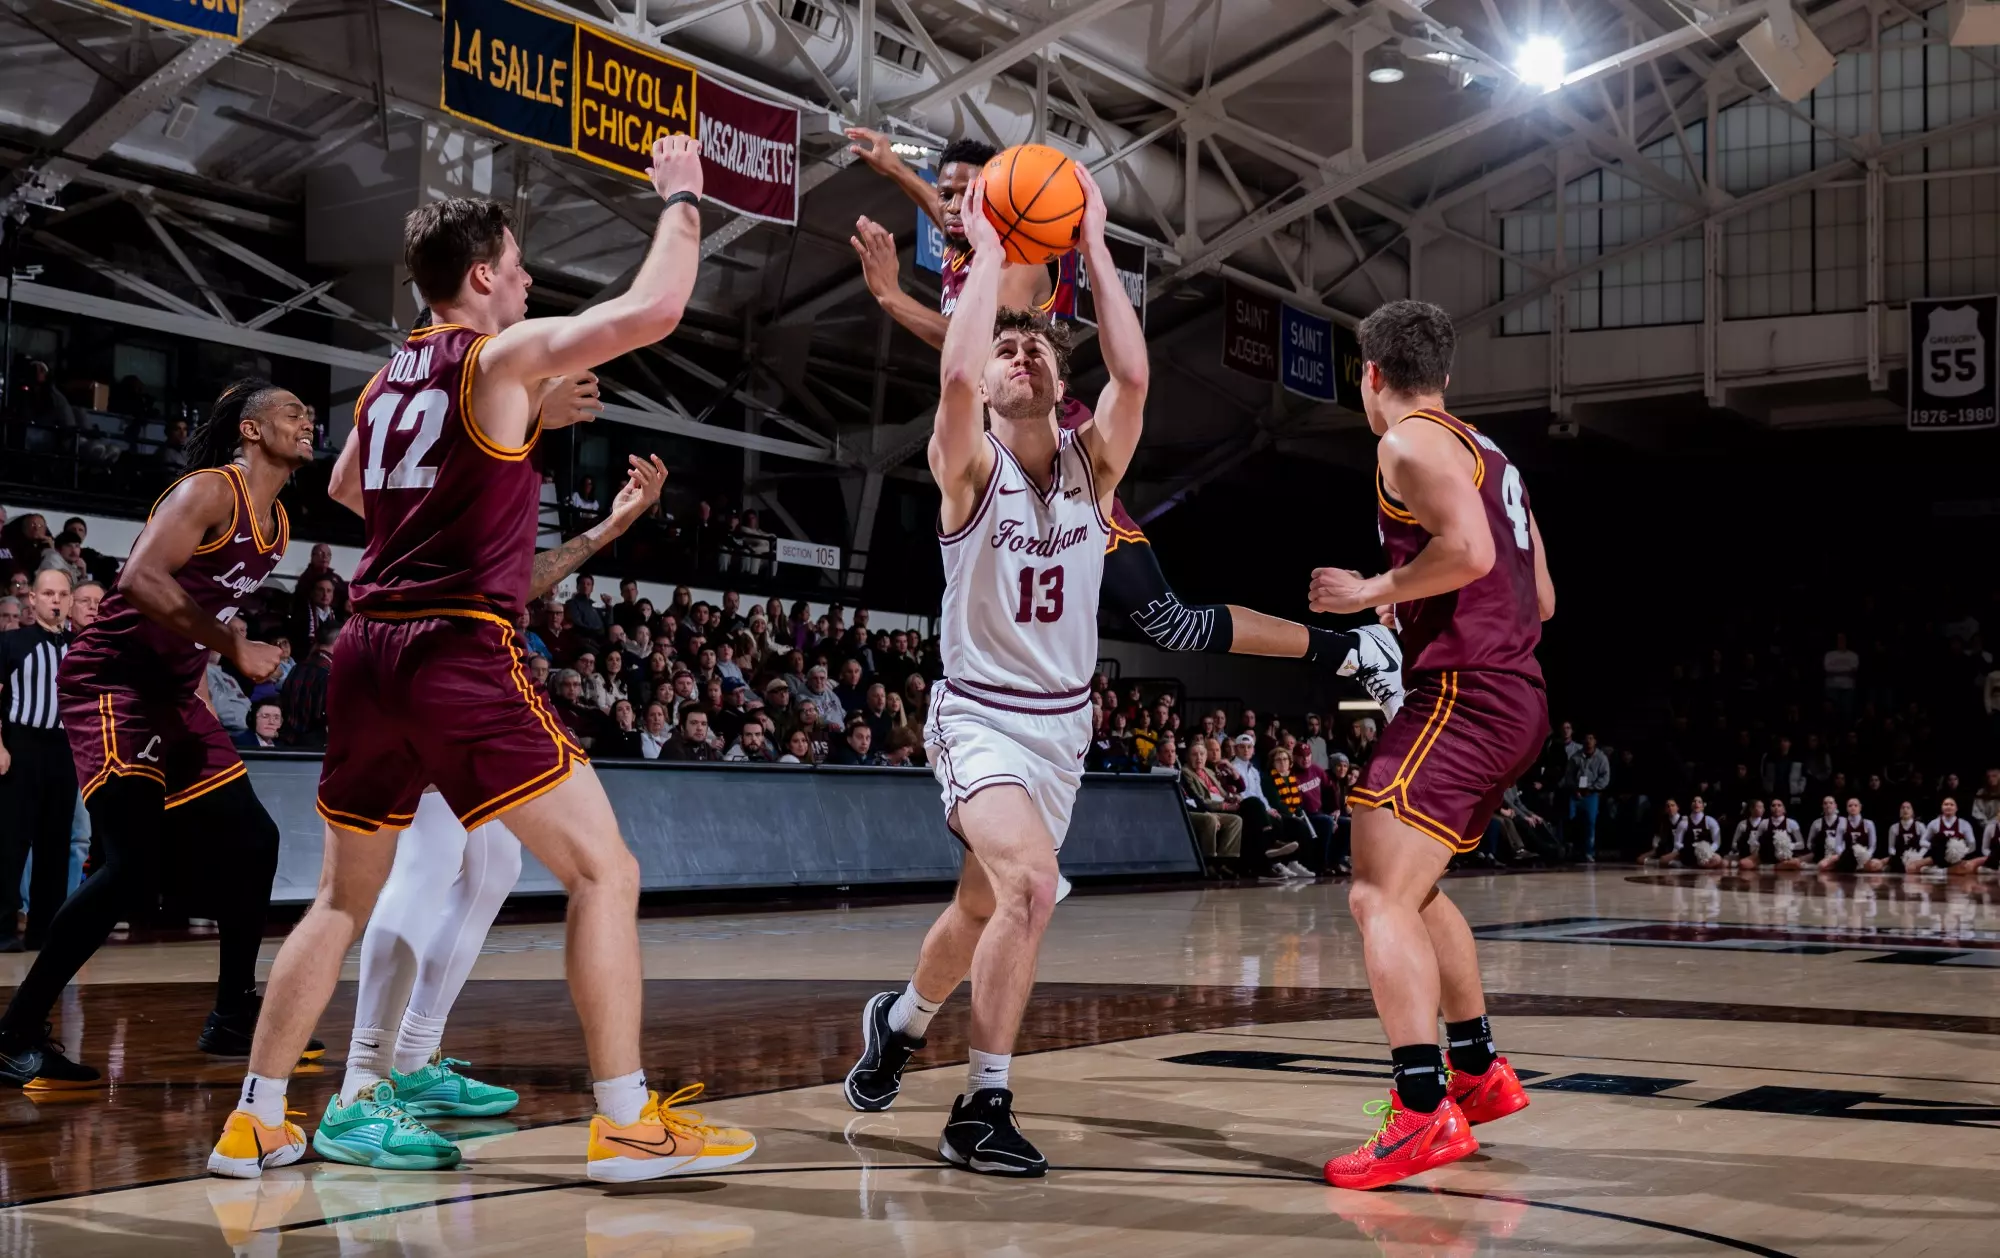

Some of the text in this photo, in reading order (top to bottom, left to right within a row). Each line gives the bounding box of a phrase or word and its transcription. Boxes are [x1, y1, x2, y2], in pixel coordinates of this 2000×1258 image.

[451, 19, 567, 108] LA SALLE
[586, 50, 687, 121] LOYOLA
[582, 98, 685, 155] CHICA
[699, 111, 794, 185] MASSACHUSETTS
[1235, 299, 1269, 333] SAINT
[1229, 335, 1274, 371] JOSEPH
[1290, 321, 1324, 355] SAINT
[1290, 353, 1325, 386] LOUIS
[1344, 353, 1362, 387] VC
[1930, 348, 1976, 383] 55
[1912, 407, 1994, 424] 1976-1980
[364, 389, 449, 490] 12
[782, 545, 835, 566] SECTION 105
[991, 519, 1088, 558] Fordham
[1015, 564, 1064, 623] 13
